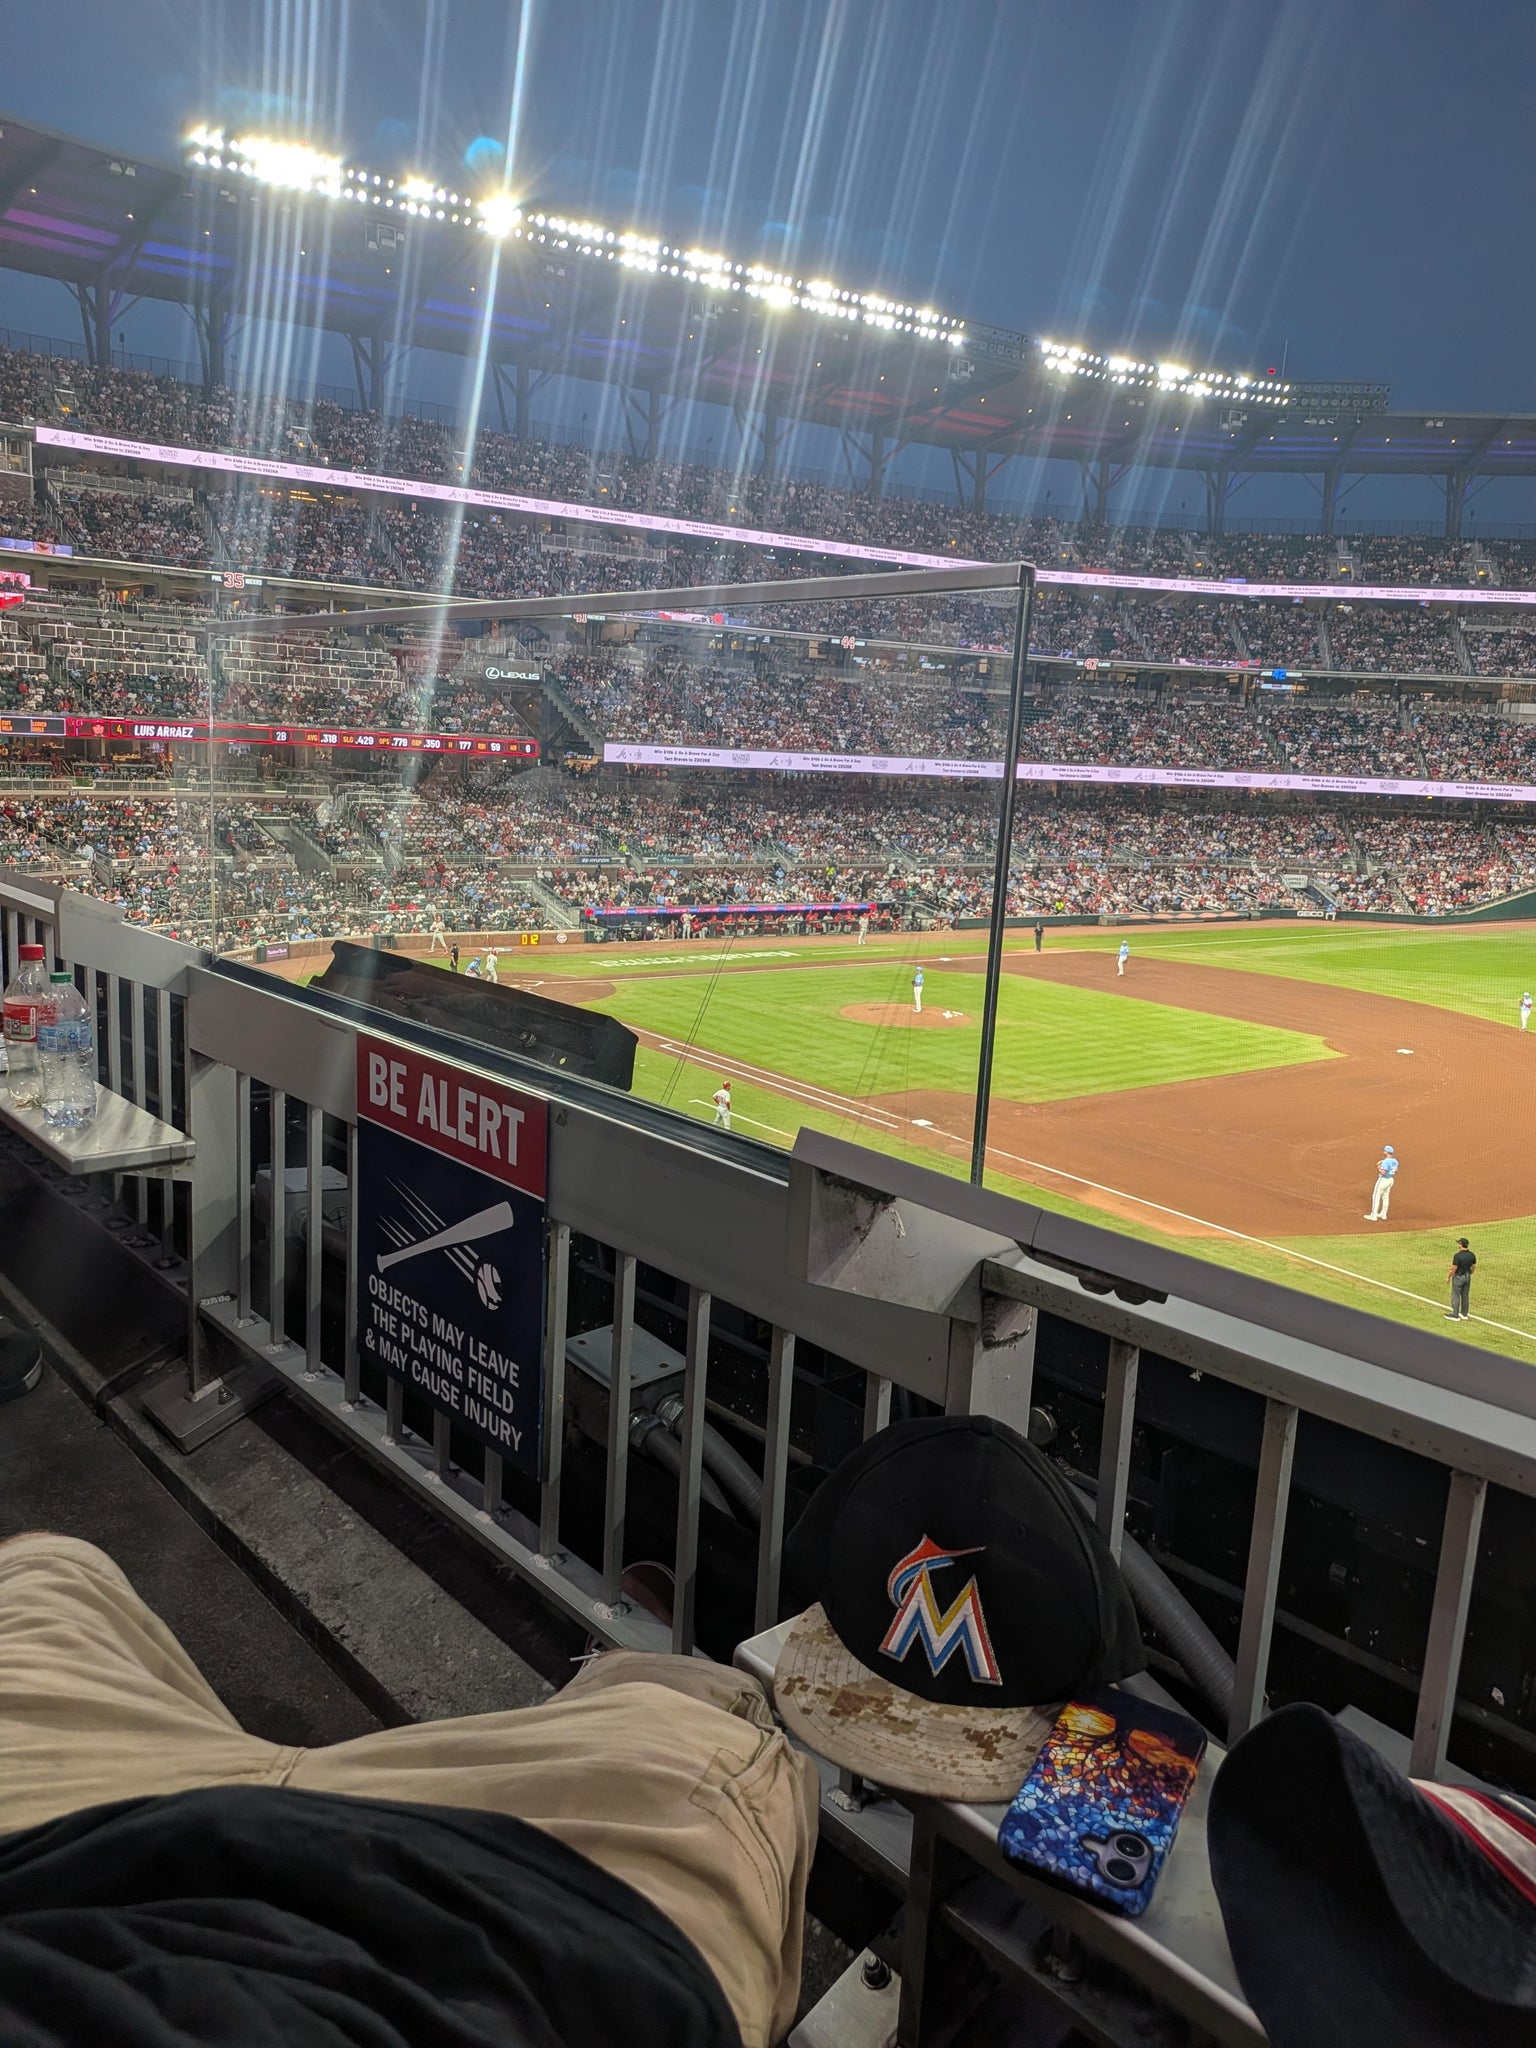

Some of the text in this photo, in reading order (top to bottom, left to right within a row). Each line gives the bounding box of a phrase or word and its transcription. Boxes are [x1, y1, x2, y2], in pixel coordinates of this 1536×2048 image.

[224, 572, 244, 588] 35
[501, 670, 539, 680] LEXUS
[841, 636, 855, 649] 44
[1085, 658, 1099, 670] 47
[116, 724, 122, 734] 4
[134, 725, 155, 737] LUIS
[157, 726, 194, 738] ARRAEZ
[276, 732, 287, 741] 2B
[321, 734, 337, 743] .318
[355, 736, 374, 745] .429
[391, 737, 408, 746] .779
[424, 739, 440, 748] .350
[459, 741, 471, 750] 177
[368, 1052, 524, 1166] BE ALERT
[368, 1274, 520, 1388] OBJECTS MAY LEAVE
[372, 1302, 514, 1415] THE PLAYING FIELD
[365, 1327, 523, 1452] & MAY CAUSE INJURY
[878, 1558, 1003, 1686] M
